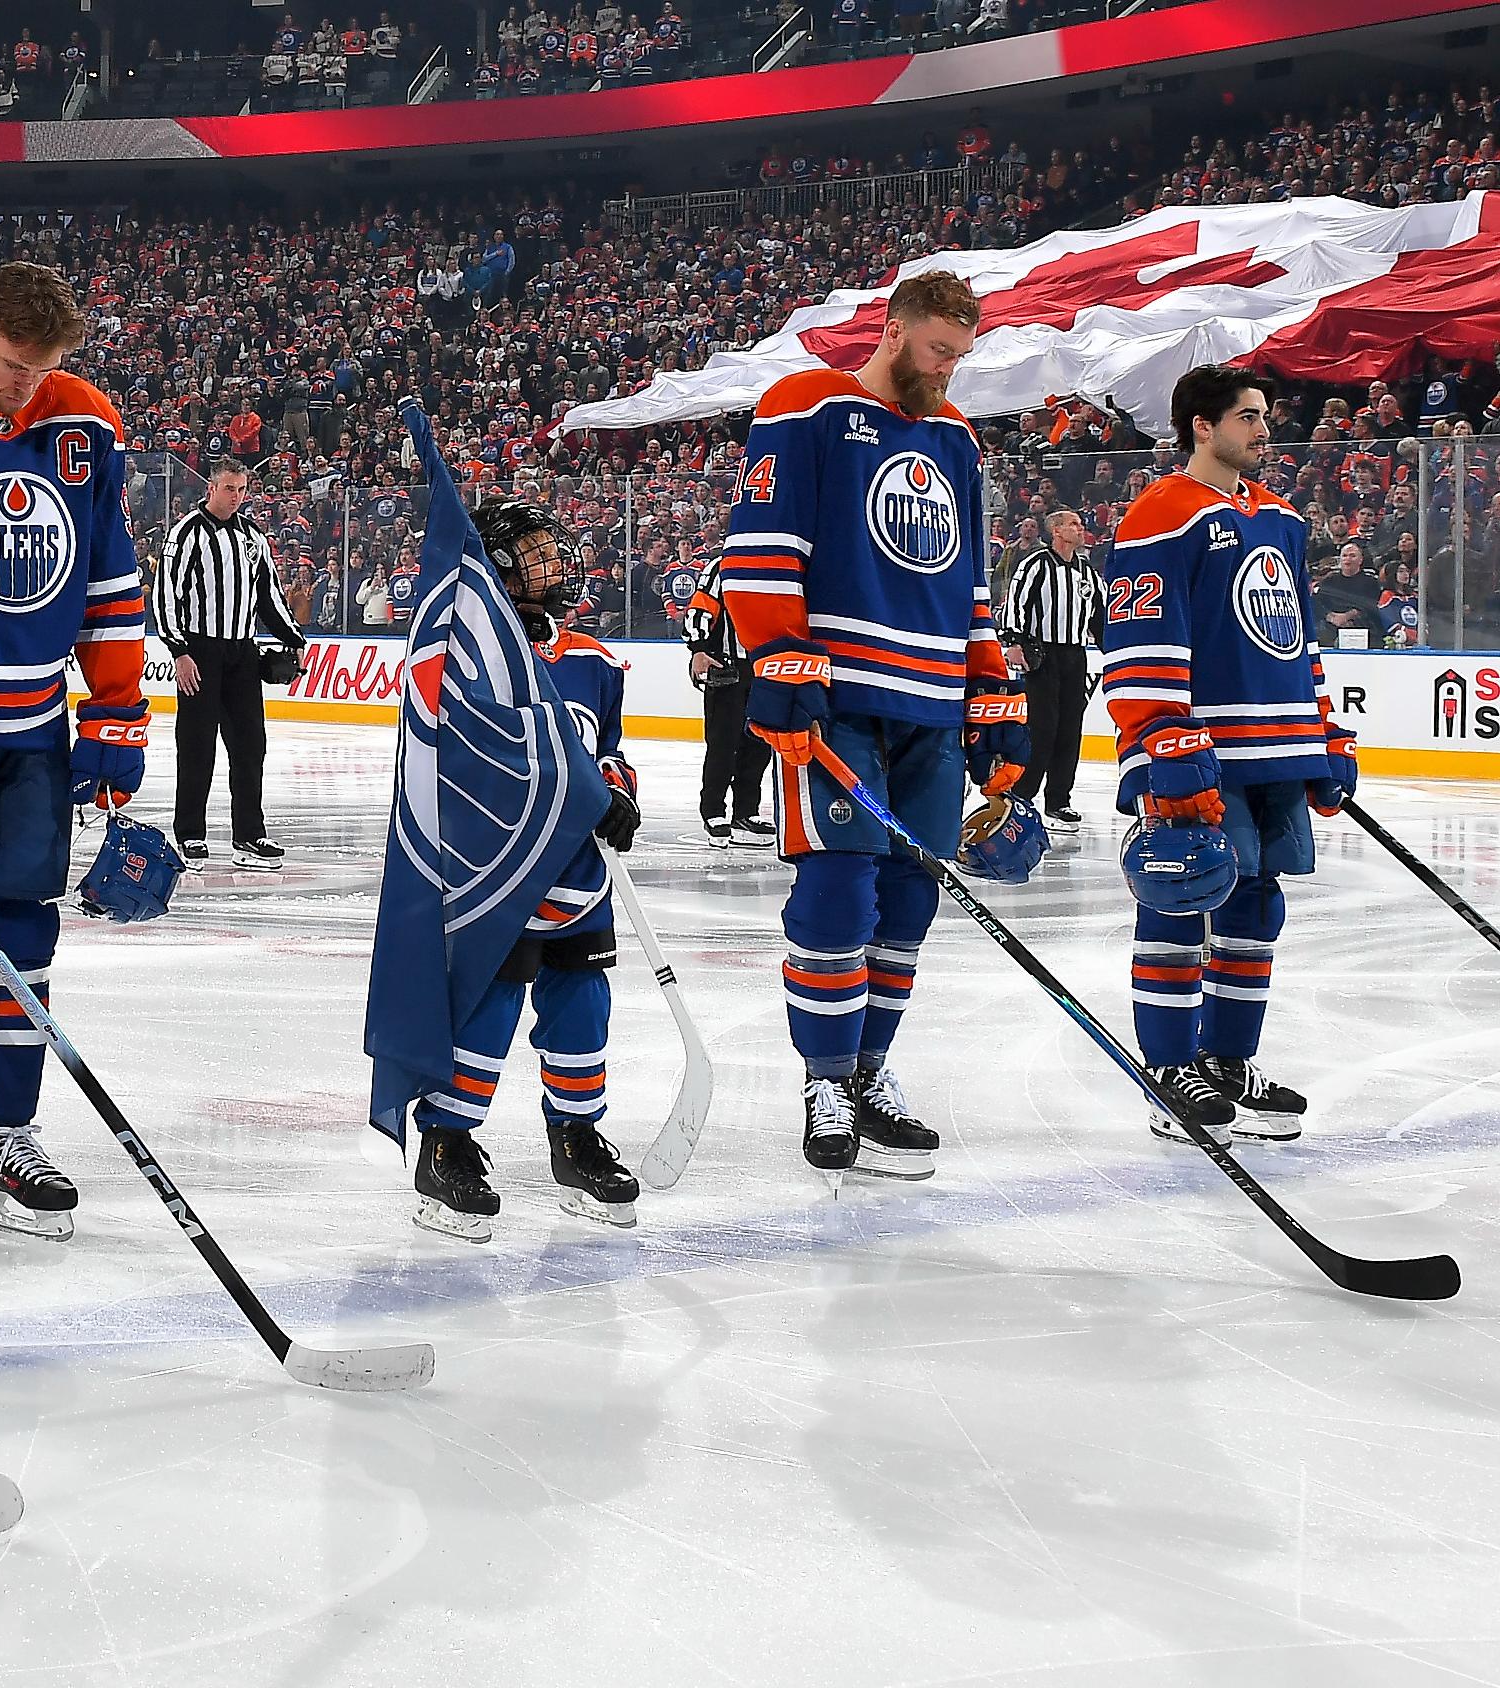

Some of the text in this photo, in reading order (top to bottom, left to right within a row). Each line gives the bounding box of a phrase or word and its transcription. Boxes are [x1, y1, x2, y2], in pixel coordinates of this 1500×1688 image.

[844, 432, 879, 446] alberta
[859, 424, 879, 438] play
[55, 429, 92, 486] C
[884, 492, 951, 561] OILERS
[1108, 572, 1163, 624] 22
[144, 651, 176, 682] oor
[98, 725, 149, 742] CC
[73, 779, 91, 793] CCM
[950, 887, 1009, 944] BAUER
[115, 1130, 206, 1239] CCM
[1201, 1143, 1261, 1199] FLYLITE
